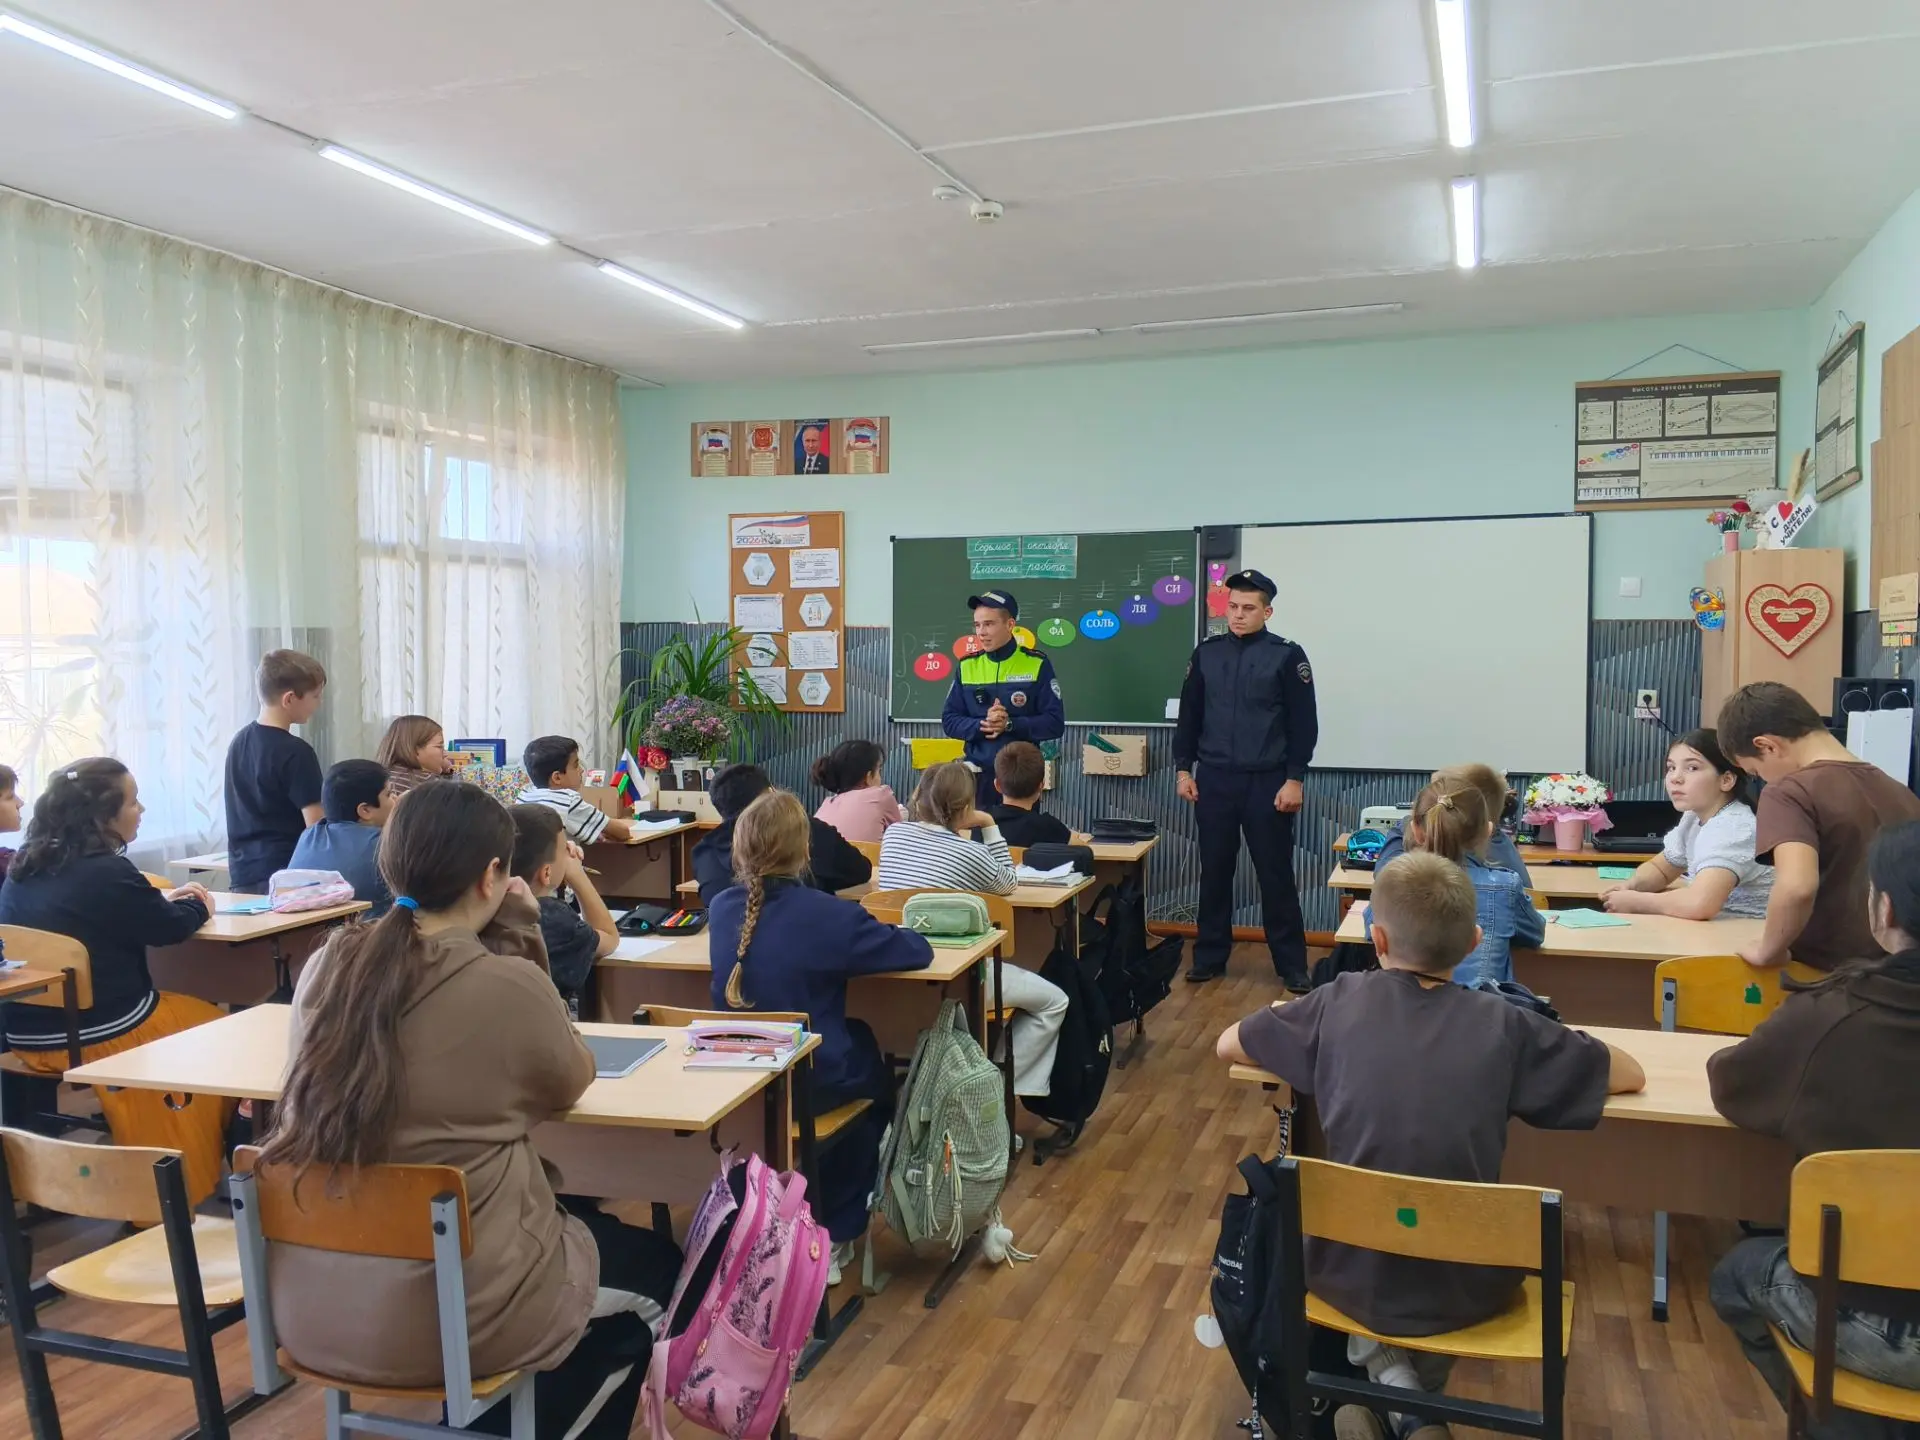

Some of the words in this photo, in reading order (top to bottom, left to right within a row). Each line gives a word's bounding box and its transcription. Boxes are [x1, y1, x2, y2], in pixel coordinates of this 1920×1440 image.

[1771, 516, 1779, 528] С
[1780, 505, 1813, 546] УЧИТЕЛЯ!
[974, 539, 1012, 555] Седьмое
[1027, 538, 1070, 554] октября
[972, 563, 1018, 574] Классная
[1026, 559, 1066, 577] работа
[1165, 584, 1181, 593] СИ
[1131, 604, 1147, 613] ЛЯ
[1086, 619, 1114, 628] СОЛЬ
[1049, 627, 1065, 636] ФА
[966, 643, 978, 652] РЕ
[925, 660, 940, 671] ДО
